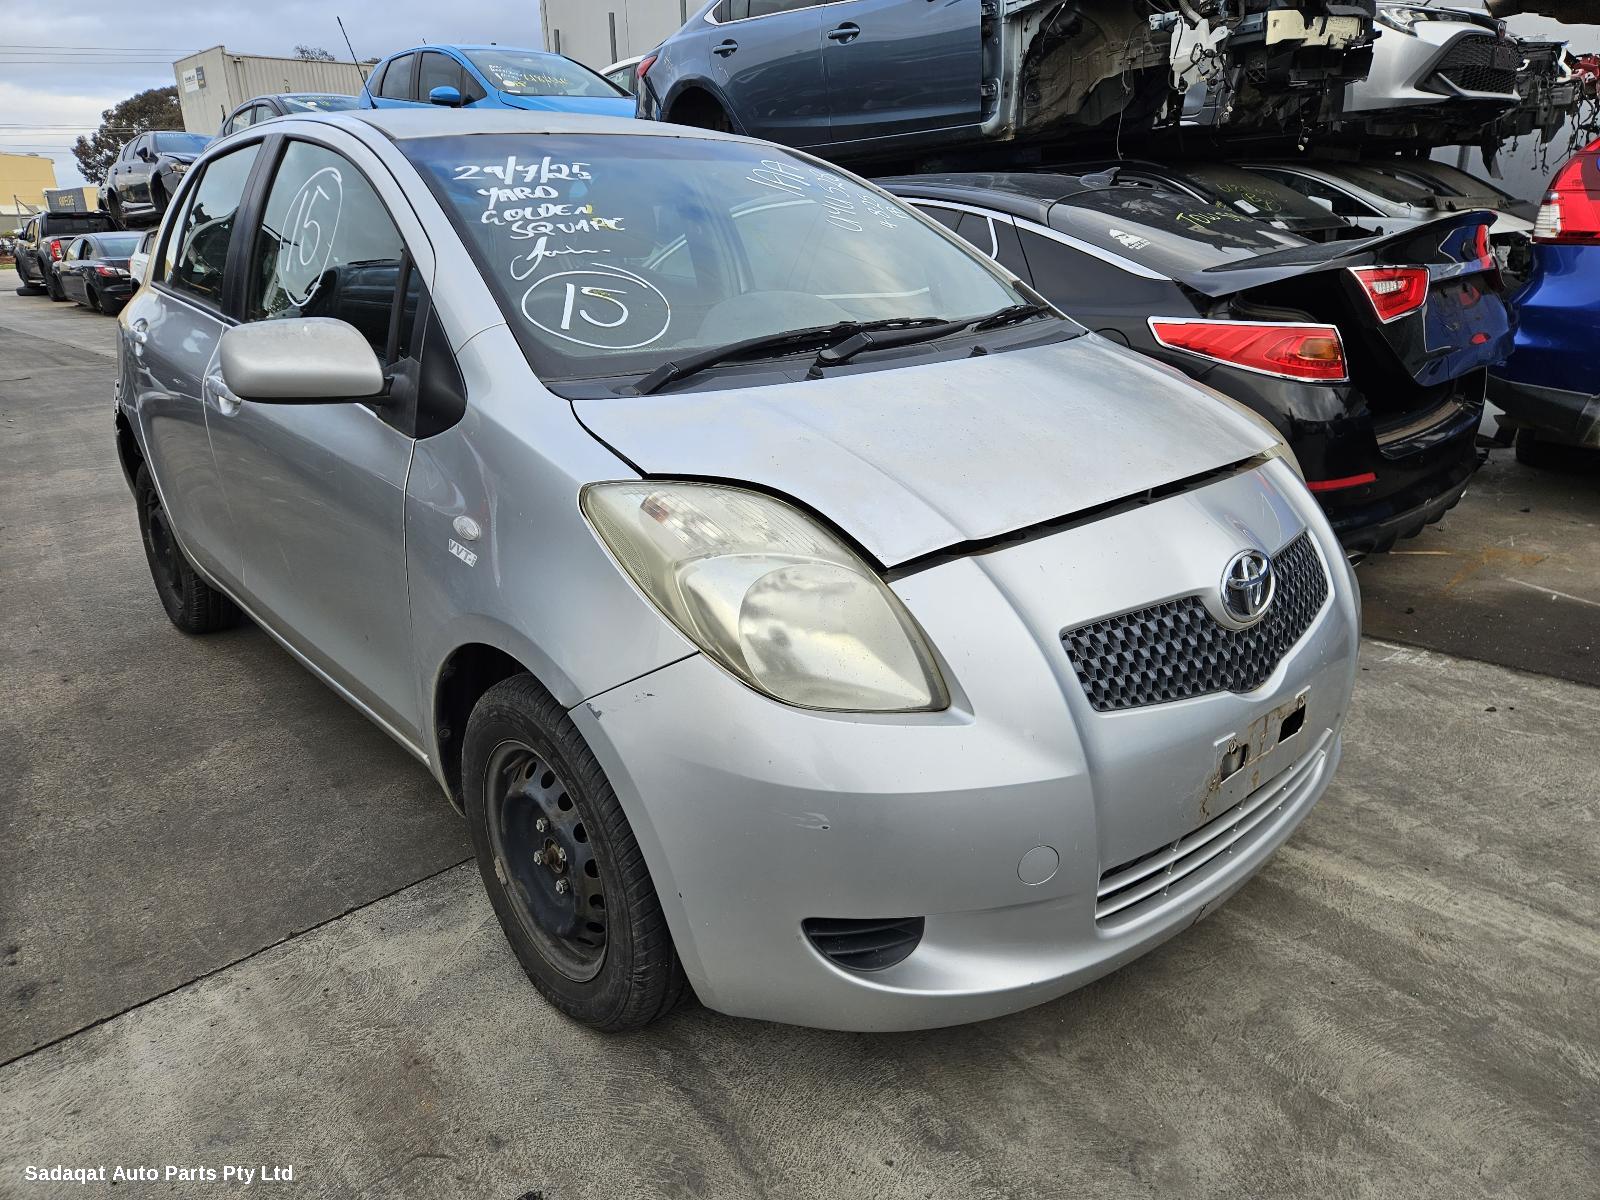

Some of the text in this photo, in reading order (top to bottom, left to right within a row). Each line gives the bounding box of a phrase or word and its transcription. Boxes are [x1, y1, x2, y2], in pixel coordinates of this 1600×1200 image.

[453, 155, 593, 185] 29/7/25
[477, 185, 559, 210] YARD
[480, 203, 593, 226] GOLDEN
[509, 217, 626, 240] SQUARE
[560, 282, 629, 331] 15
